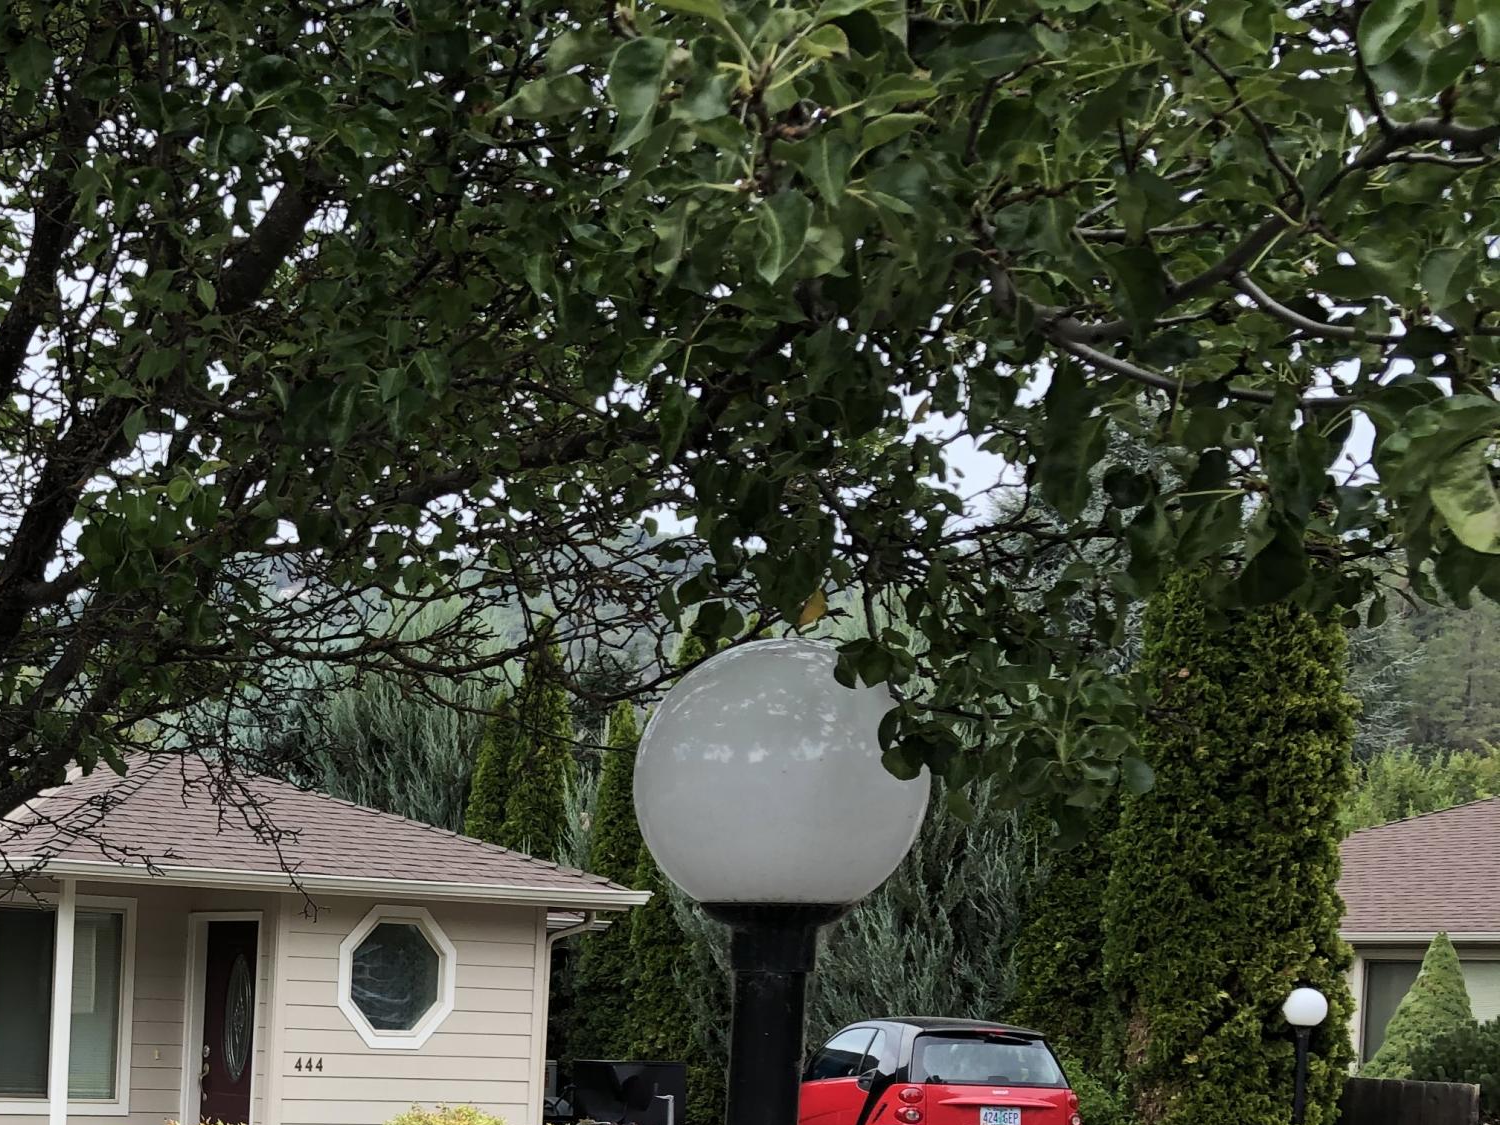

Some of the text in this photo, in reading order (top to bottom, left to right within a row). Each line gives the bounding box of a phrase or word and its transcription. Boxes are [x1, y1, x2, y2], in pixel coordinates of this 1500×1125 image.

[294, 1056, 323, 1072] 444
[983, 1111, 1019, 1125] 424 GEP
